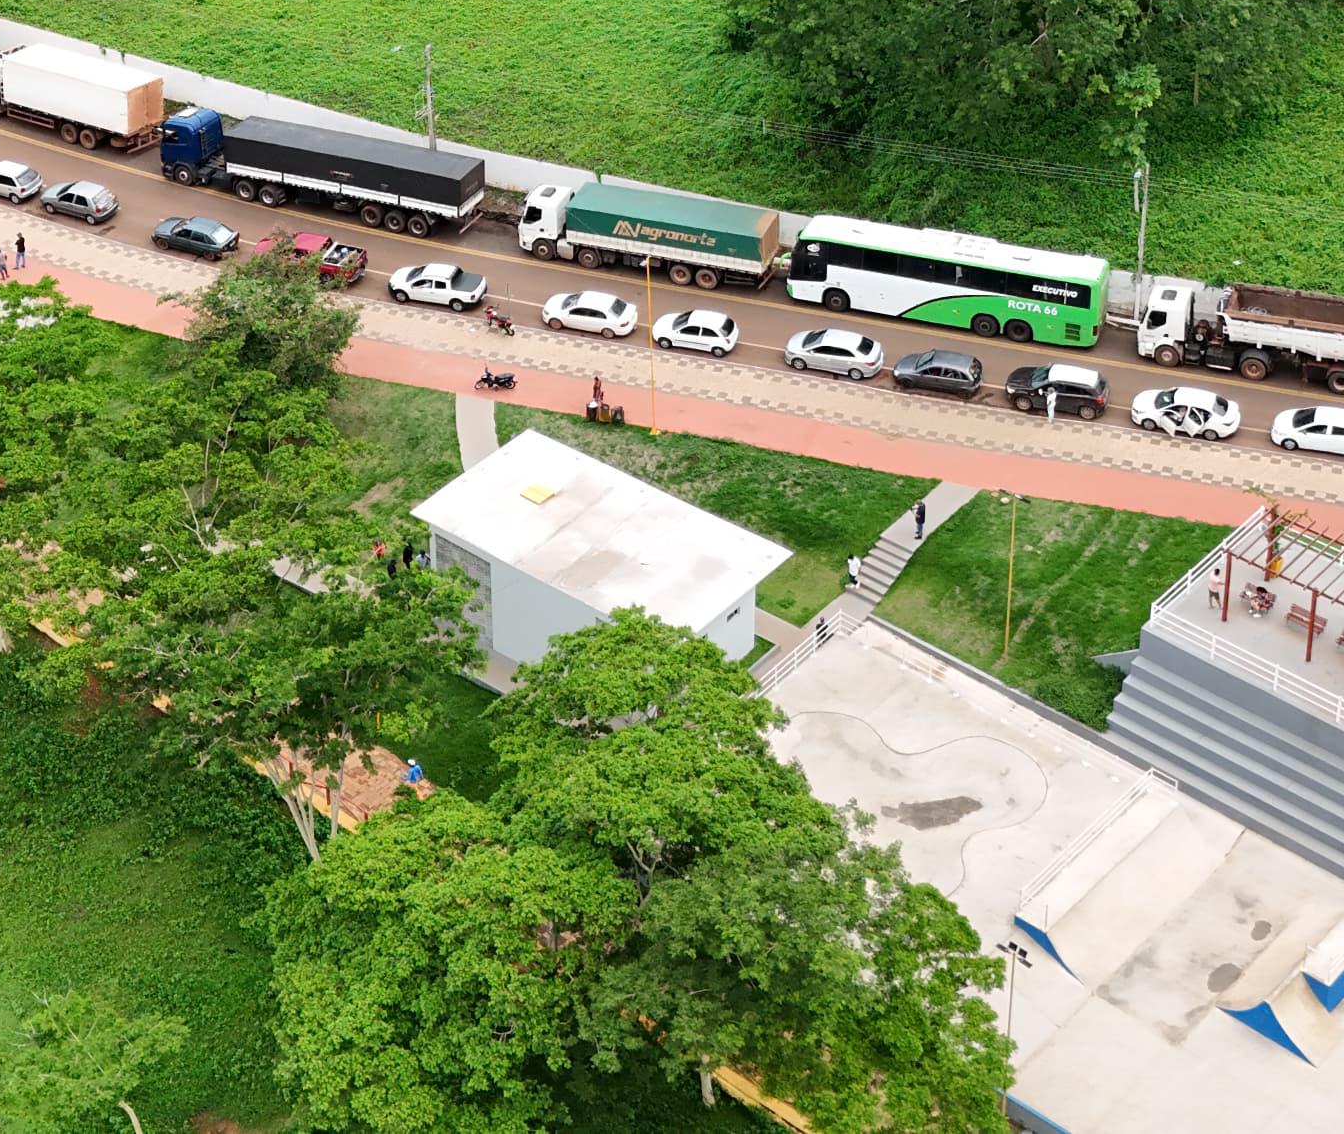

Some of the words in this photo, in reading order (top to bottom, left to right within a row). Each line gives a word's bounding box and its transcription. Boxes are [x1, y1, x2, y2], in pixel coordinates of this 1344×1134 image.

[641, 225, 716, 247] agronorte
[1032, 284, 1078, 299] EXECUTIVO
[1007, 299, 1042, 315] ROTA
[1044, 306, 1058, 316] 66
